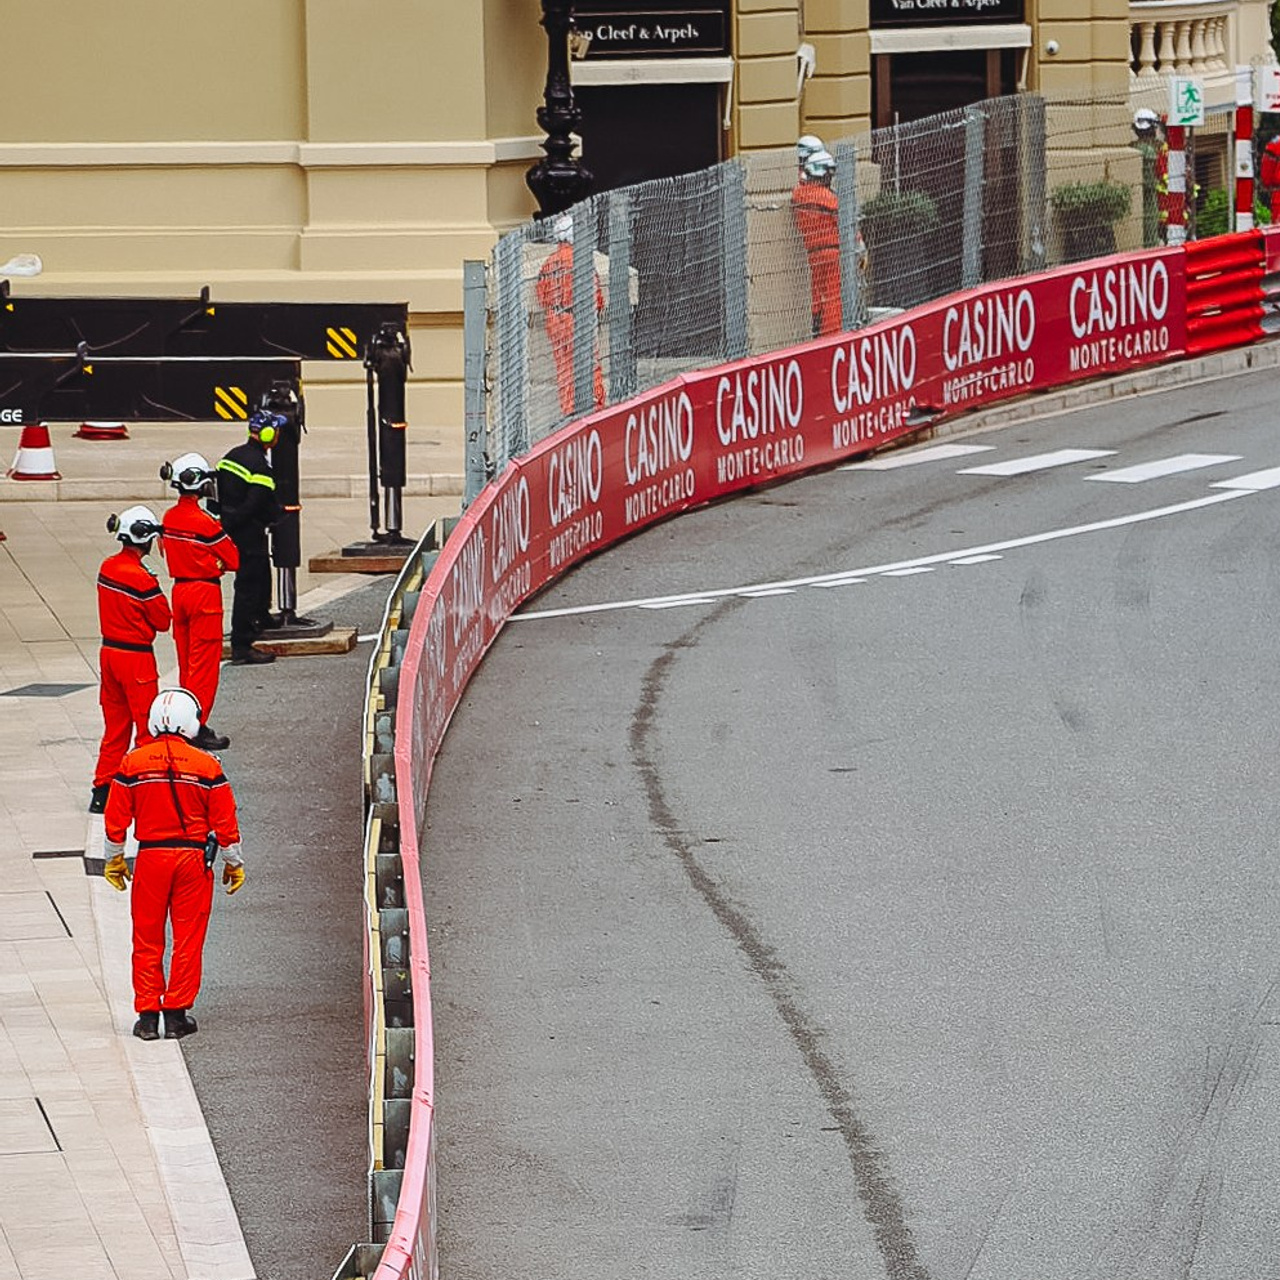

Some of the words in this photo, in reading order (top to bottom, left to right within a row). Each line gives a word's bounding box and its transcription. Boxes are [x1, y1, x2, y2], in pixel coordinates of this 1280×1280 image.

[597, 25, 636, 40] Cleef
[639, 28, 650, 39] &
[652, 24, 699, 43] Arpels
[943, 289, 1035, 371] CASINO
[1070, 260, 1168, 339] CASINO
[716, 359, 802, 446] CASINO
[832, 325, 916, 413] CASINO
[548, 430, 602, 527] CASINO
[625, 392, 694, 486] CASINO
